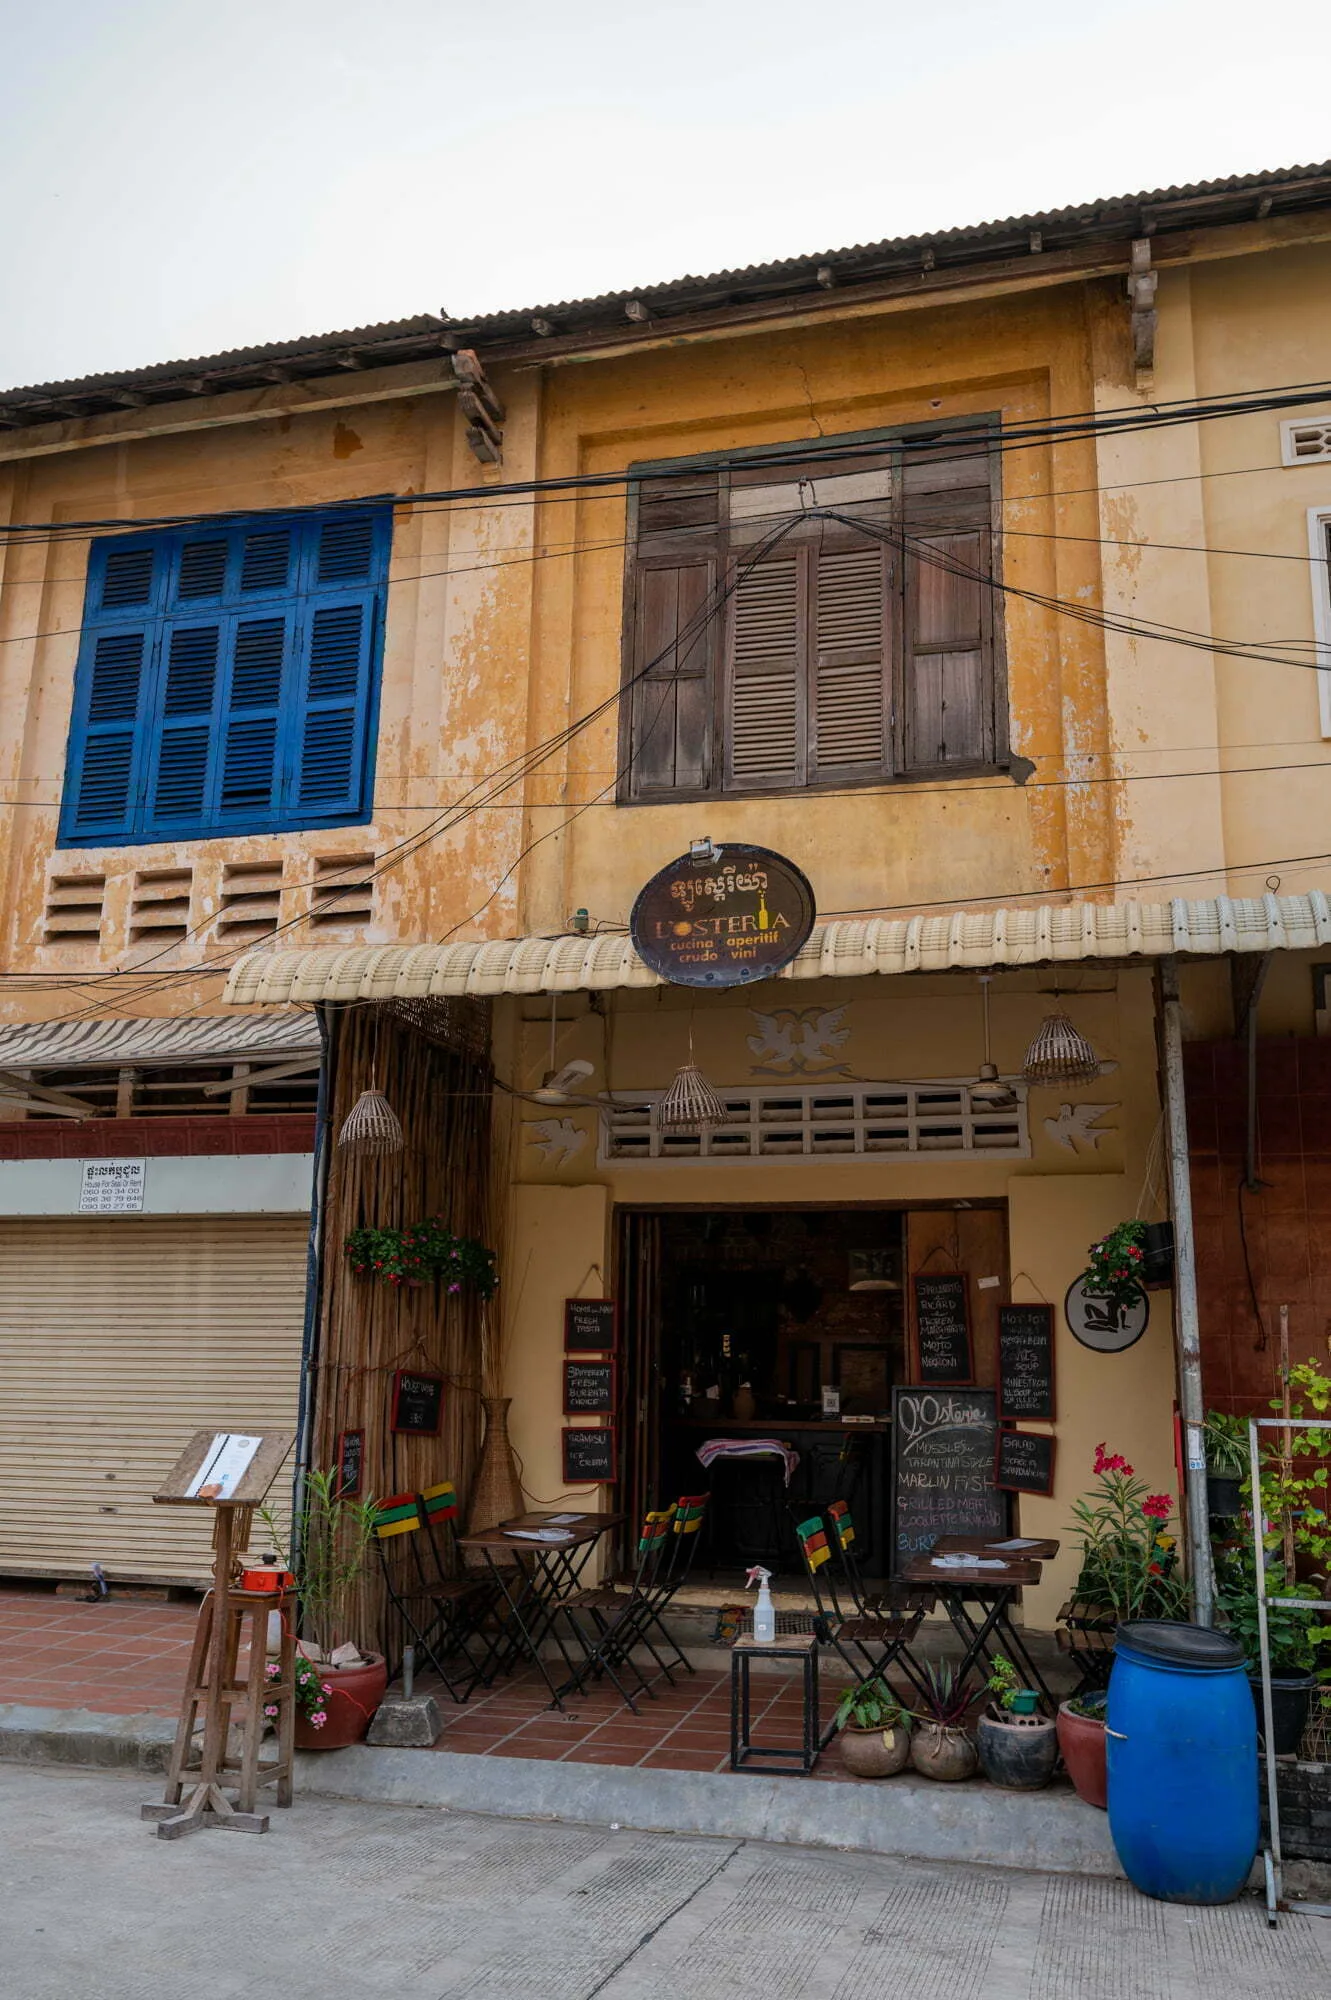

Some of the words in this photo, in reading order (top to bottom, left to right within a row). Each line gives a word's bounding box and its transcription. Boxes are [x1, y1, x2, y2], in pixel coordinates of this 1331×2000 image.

[671, 939, 714, 951] cucina
[727, 931, 780, 948] aperitif
[680, 950, 718, 963] crudo
[731, 947, 757, 959] vini
[1003, 1436, 1037, 1452] SALAD
[897, 1471, 950, 1490] MARLIN
